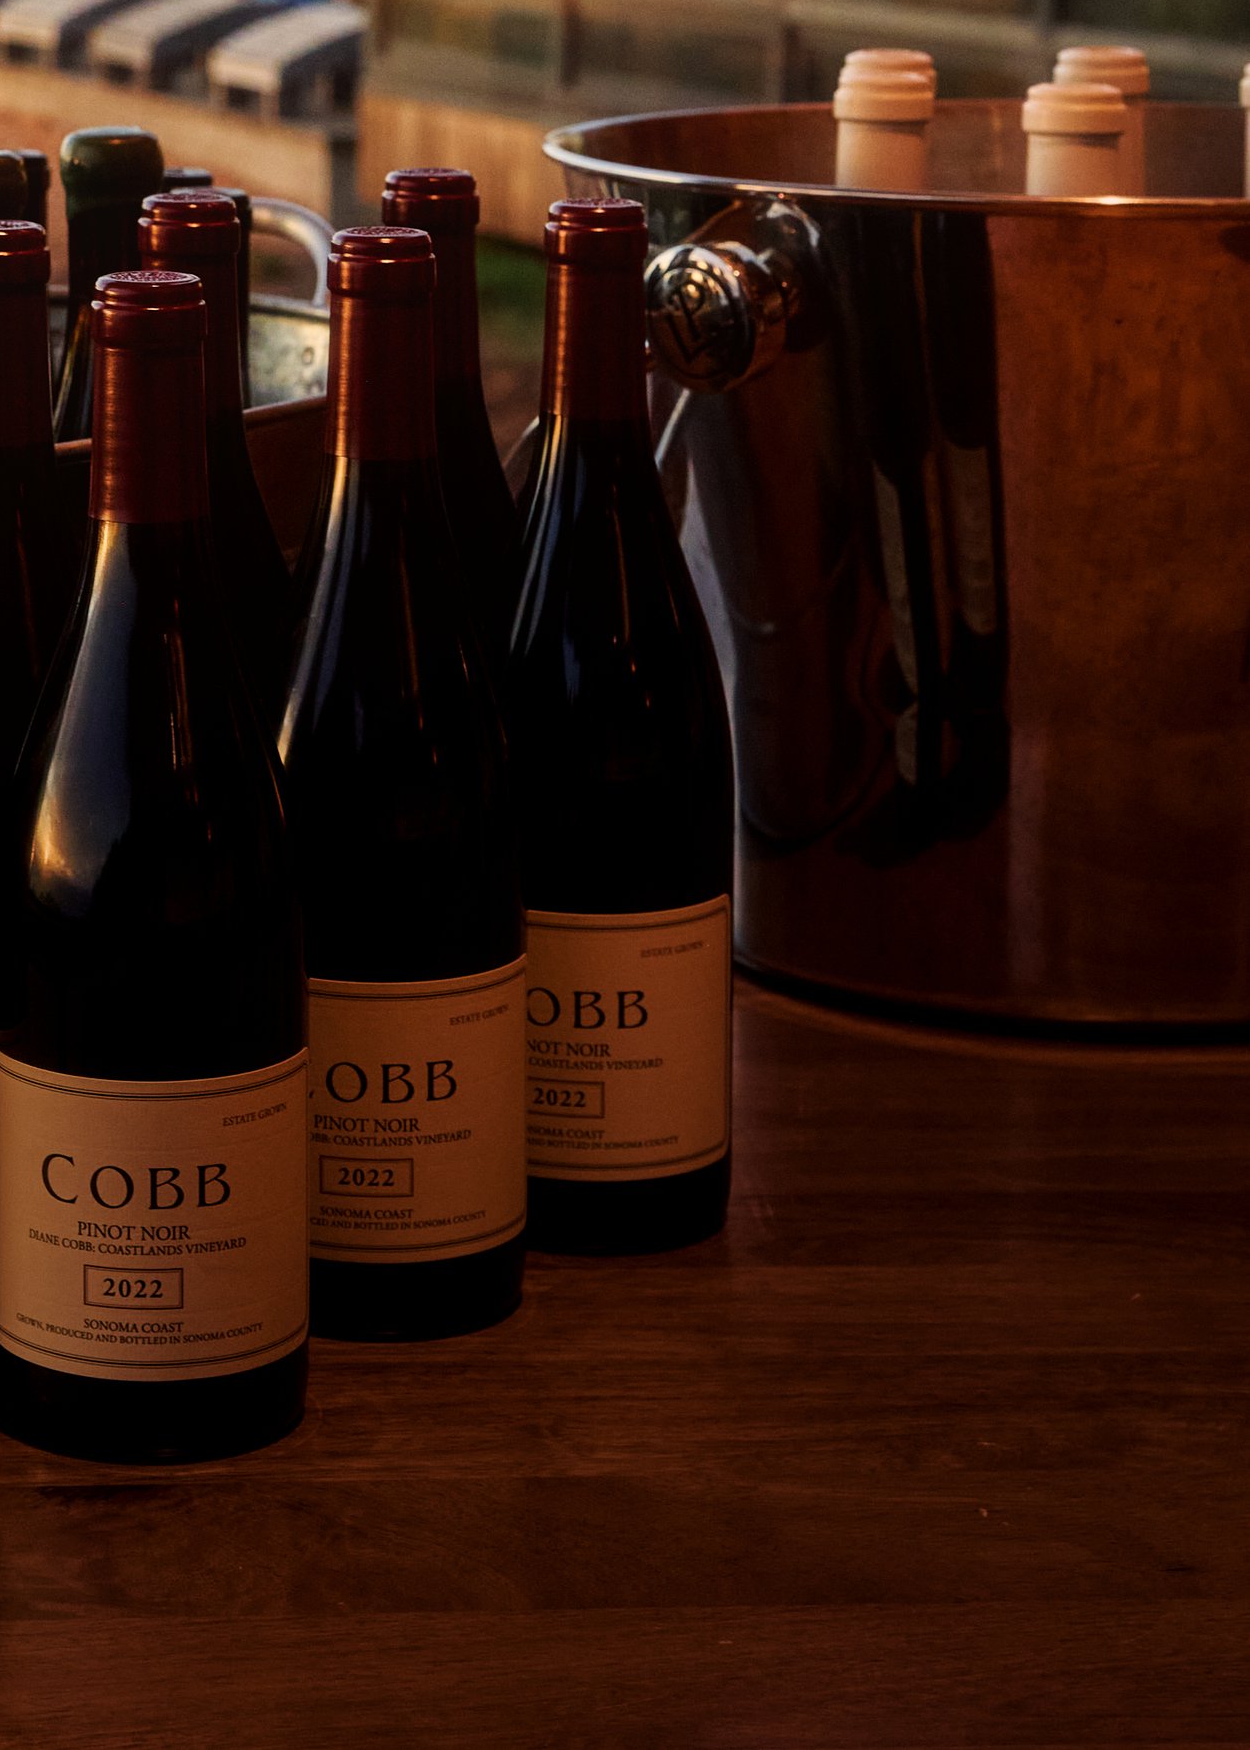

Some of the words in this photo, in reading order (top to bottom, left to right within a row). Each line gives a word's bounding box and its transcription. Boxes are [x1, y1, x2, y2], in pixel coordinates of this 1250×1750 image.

[527, 987, 648, 1029] OBB
[527, 1039, 561, 1055] NOT
[566, 1042, 611, 1057] NOIR
[529, 1057, 603, 1071] COASTLANDS
[606, 1058, 664, 1070] VINEYARD
[309, 1060, 457, 1103] OBB
[533, 1087, 586, 1108] 2022
[222, 1112, 257, 1126] ESTATE
[258, 1102, 287, 1120] GROWN
[314, 1115, 369, 1132] PINOT
[374, 1117, 420, 1132] NOIR
[333, 1133, 413, 1147] COASTLANDS
[415, 1130, 472, 1145] VINEYARD
[527, 1125, 564, 1139] NOMA
[566, 1129, 605, 1140] COAST
[41, 1153, 231, 1210] COBB
[338, 1167, 395, 1186] 2022
[319, 1205, 372, 1219] SONOMA
[374, 1208, 415, 1220] COAST
[77, 1221, 136, 1240] PINOT
[141, 1225, 191, 1240] NOIR
[331, 1219, 351, 1229] AND
[353, 1221, 399, 1231] BOTTLED
[400, 1221, 411, 1230] IN
[413, 1217, 451, 1230] SONOMA
[29, 1228, 59, 1246] DIANE
[62, 1237, 96, 1252] COBB:
[98, 1243, 183, 1256] COASTLANDS
[185, 1237, 247, 1254] VINEYARD
[103, 1278, 163, 1298] 2022
[16, 1313, 45, 1331] GROWN,
[46, 1323, 94, 1341] PRODUCED
[96, 1334, 117, 1344] AND
[119, 1335, 167, 1345] BOTTLED
[169, 1335, 180, 1344] IN
[182, 1331, 225, 1344] SONOMA
[226, 1322, 264, 1339] COUNTY
[83, 1318, 139, 1333] SONOMA
[141, 1322, 184, 1333] COAST
